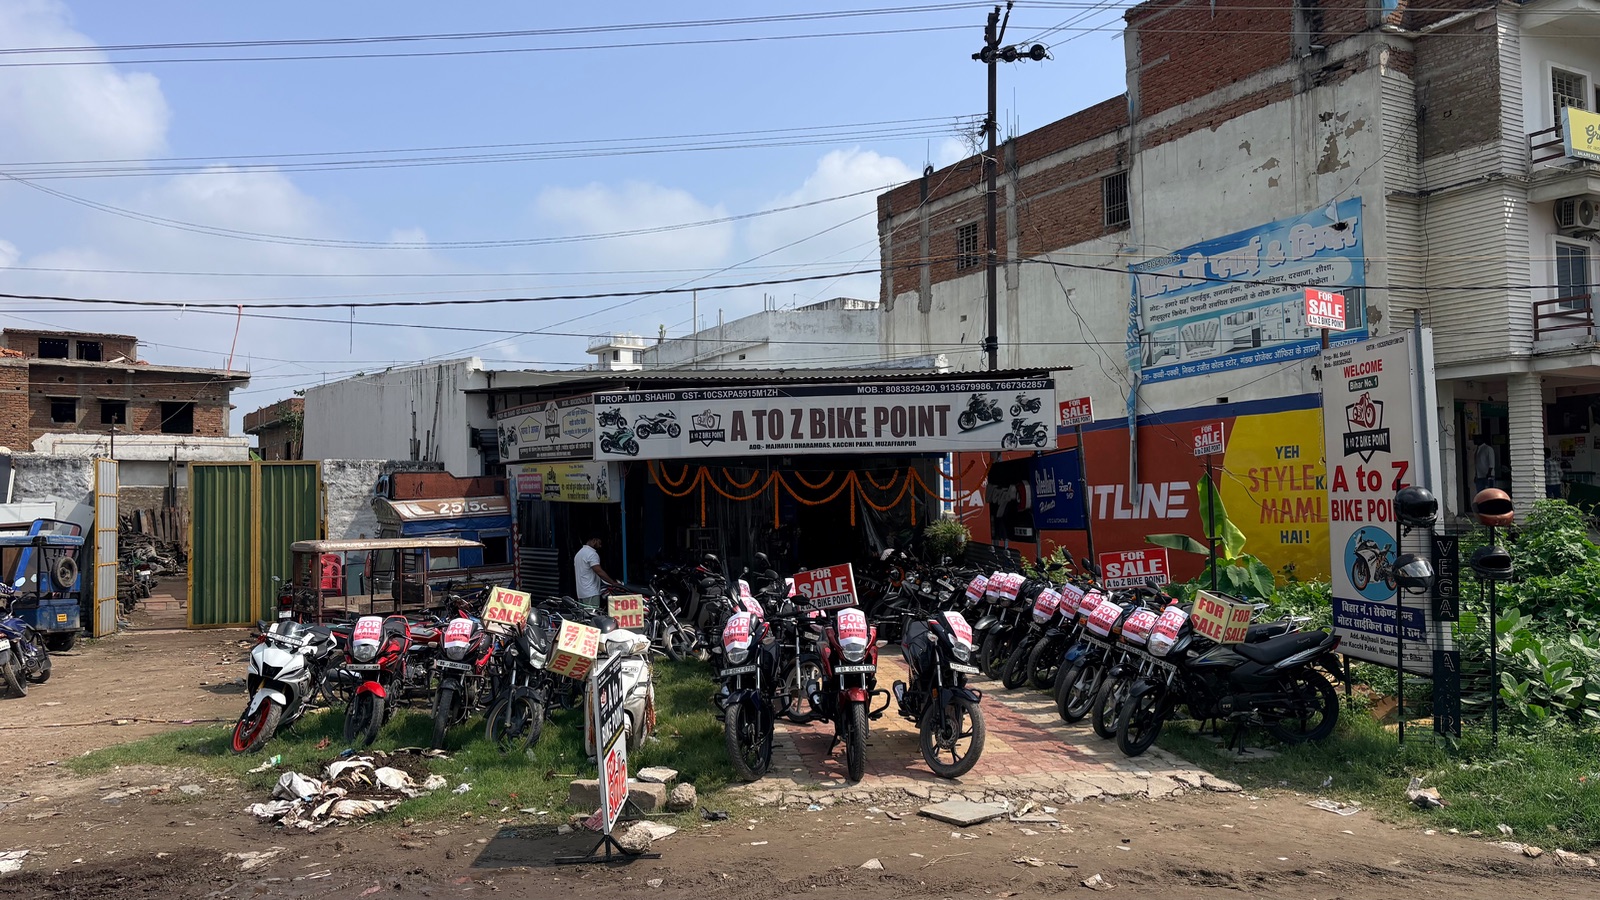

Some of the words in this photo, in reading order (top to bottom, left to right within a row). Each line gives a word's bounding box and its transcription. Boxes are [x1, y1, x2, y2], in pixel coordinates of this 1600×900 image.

[1267, 240, 1285, 267] &
[1318, 292, 1332, 301] FOR
[1309, 299, 1342, 318] SALE
[1321, 318, 1331, 326] BIKE
[1332, 319, 1343, 328] POINT
[1344, 359, 1382, 378] WELCOME
[940, 382, 993, 391] 9135679986,
[996, 381, 1047, 389] 7667362857
[1350, 380, 1363, 390] Bihar
[1364, 378, 1373, 387] No.
[1374, 377, 1377, 386] 1
[645, 393, 675, 401] SHAHID
[682, 391, 701, 399] GST-
[1062, 405, 1089, 418] SALE
[731, 411, 747, 441] A
[752, 409, 783, 440] TO
[791, 409, 803, 439] Z
[810, 407, 868, 439] BIKE
[874, 405, 950, 438] POINT
[1201, 425, 1212, 433] FOR
[1195, 432, 1220, 447] SALE
[1355, 436, 1358, 448] Z
[1360, 435, 1371, 448] BIKE
[1372, 433, 1388, 445] POINT
[1211, 444, 1221, 452] POINT
[1275, 445, 1299, 459] YEH
[1248, 465, 1314, 492] STYLE
[1332, 465, 1349, 492] A
[1356, 465, 1382, 491] to
[1392, 461, 1410, 491] Z
[1331, 499, 1363, 521] BIKE
[1280, 530, 1302, 543] HAI
[1120, 551, 1145, 561] FOR
[810, 569, 831, 580] FOR
[1106, 559, 1163, 578] SALE
[1004, 581, 1019, 589] SALE
[1005, 576, 1021, 584] FOR
[1127, 577, 1142, 585] BIKE
[799, 576, 848, 598] SALE
[496, 591, 523, 606] FOR
[818, 597, 831, 607] BIKE
[833, 594, 851, 605] POINT
[1041, 592, 1058, 604] FOR
[1064, 589, 1081, 602] FOR
[614, 599, 638, 610] FOR
[1037, 598, 1055, 608] SALE
[1198, 597, 1224, 619] FOR
[1342, 601, 1359, 613] बिहार
[488, 607, 523, 623] SALE
[1092, 611, 1114, 624] SALE
[1097, 604, 1118, 618] FOR
[1162, 611, 1184, 624] FOR
[1232, 609, 1250, 622] FOR
[613, 614, 642, 627] SALE
[727, 618, 748, 627] FOR
[840, 615, 863, 623] FOR
[1128, 618, 1150, 629] SALE
[1132, 612, 1155, 624] FOR
[1157, 620, 1179, 630] SALE
[1191, 614, 1223, 639] SALE
[725, 627, 748, 637] SALE
[1224, 627, 1247, 641] SALE
[1349, 641, 1363, 650] Kacchi
[1410, 653, 1423, 662] Bihar
[552, 654, 572, 671] FOR
[569, 657, 592, 679] SALE
